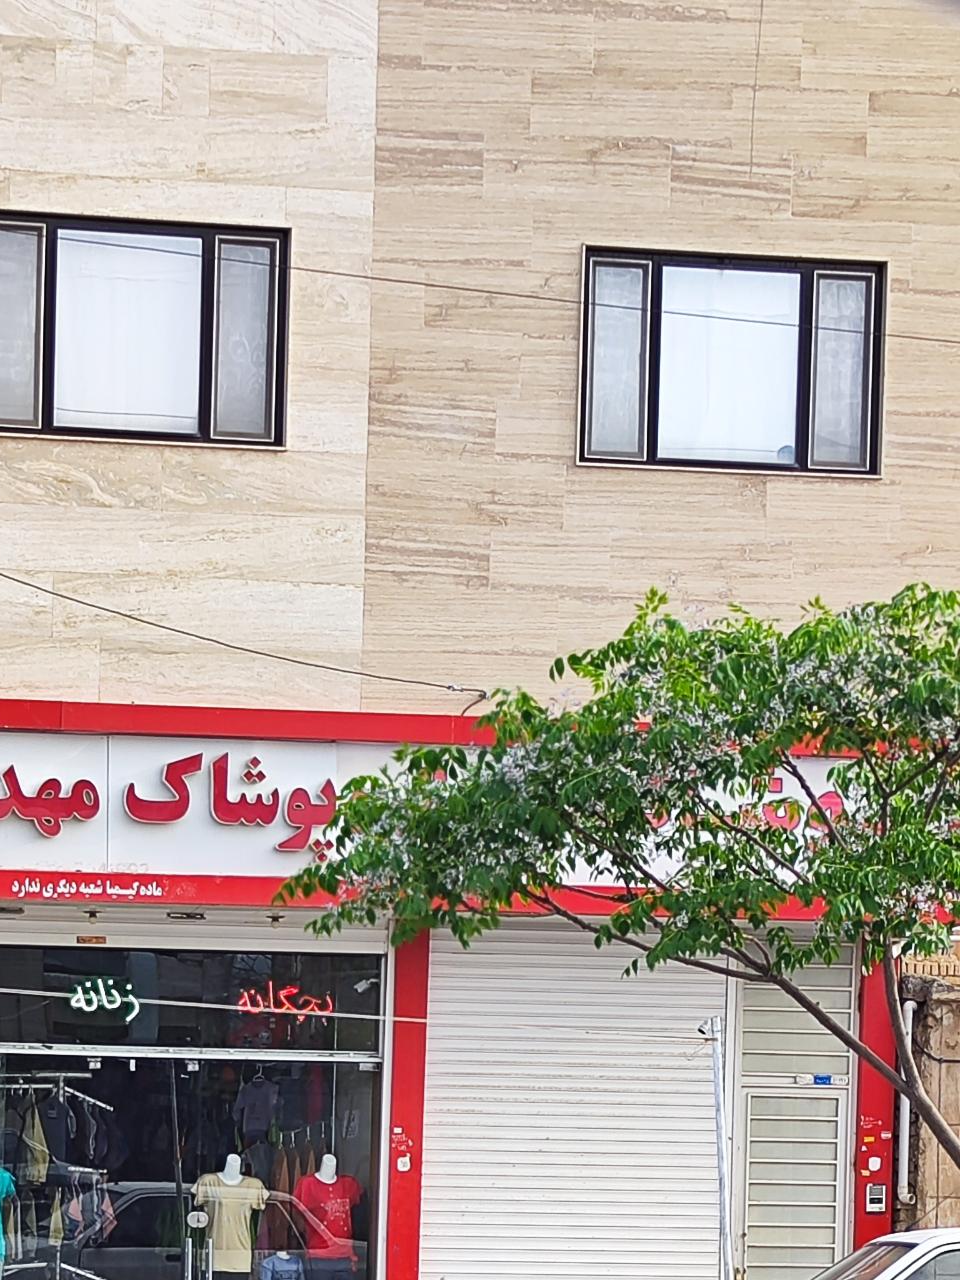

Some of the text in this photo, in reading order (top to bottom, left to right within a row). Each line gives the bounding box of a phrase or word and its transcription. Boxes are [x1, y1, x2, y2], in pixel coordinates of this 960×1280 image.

[124, 751, 337, 863] پوشاک
[11, 877, 40, 898] ندارد
[42, 878, 77, 899] دیگری
[78, 879, 103, 898] شعبه
[69, 978, 140, 1024] زنانه
[237, 980, 334, 1026] بچگانه
